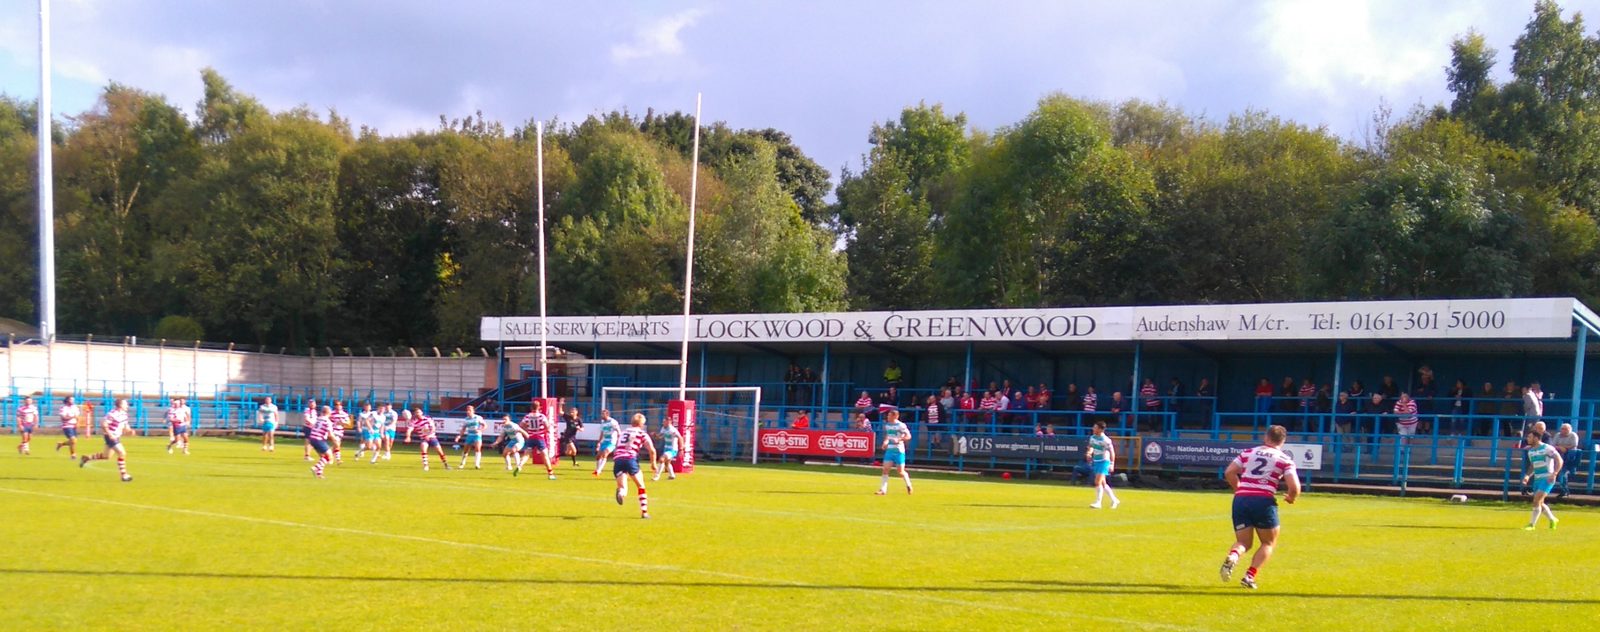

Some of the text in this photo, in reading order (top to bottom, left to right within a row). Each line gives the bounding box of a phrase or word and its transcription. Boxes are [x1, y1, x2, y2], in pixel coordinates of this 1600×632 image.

[695, 314, 1097, 339] LOCKWOOD & GREENWOOD
[1135, 309, 1506, 332] Audenshaw M/cr. Tel: 0161-301 5000
[505, 321, 670, 336] SALES SERVICE PARTS
[620, 433, 631, 444] 3
[969, 437, 993, 450] GJS
[1206, 446, 1229, 454] League
[1256, 450, 1274, 458] CLAY
[1165, 453, 1197, 462] Supporting
[1251, 457, 1268, 475] 2
